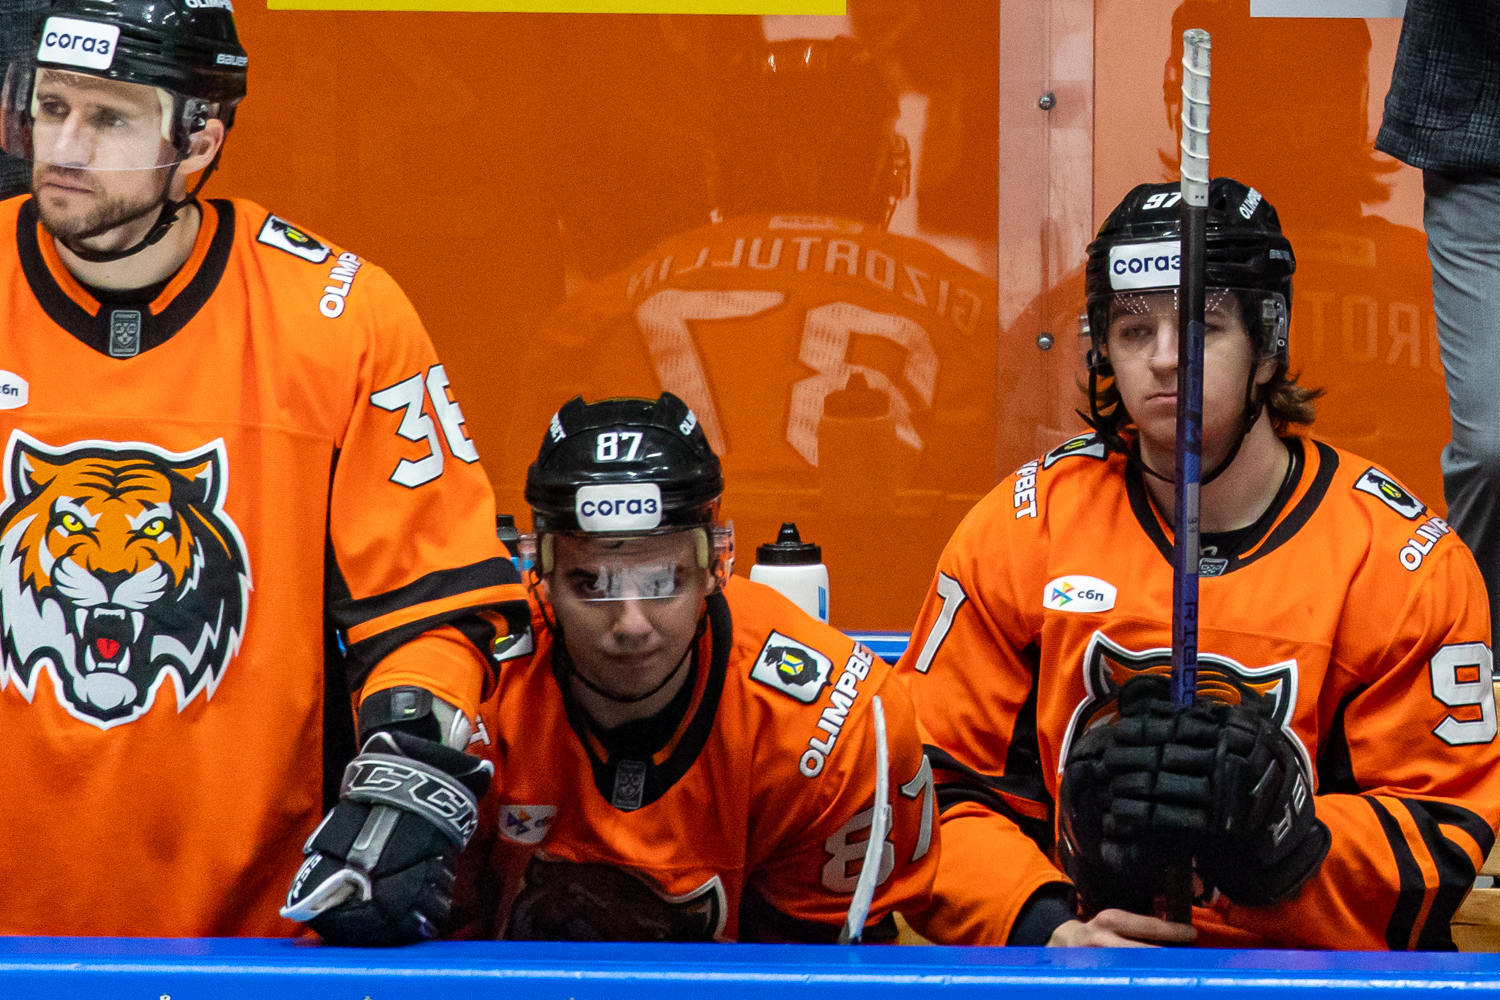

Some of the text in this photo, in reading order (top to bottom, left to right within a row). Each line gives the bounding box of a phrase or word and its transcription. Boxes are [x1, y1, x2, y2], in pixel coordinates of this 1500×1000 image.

[45, 31, 110, 56] согаз
[1142, 191, 1182, 211] 97
[596, 431, 643, 461] 87
[581, 498, 658, 517] согаз
[1077, 587, 1104, 602] сбп
[821, 753, 935, 894] 87
